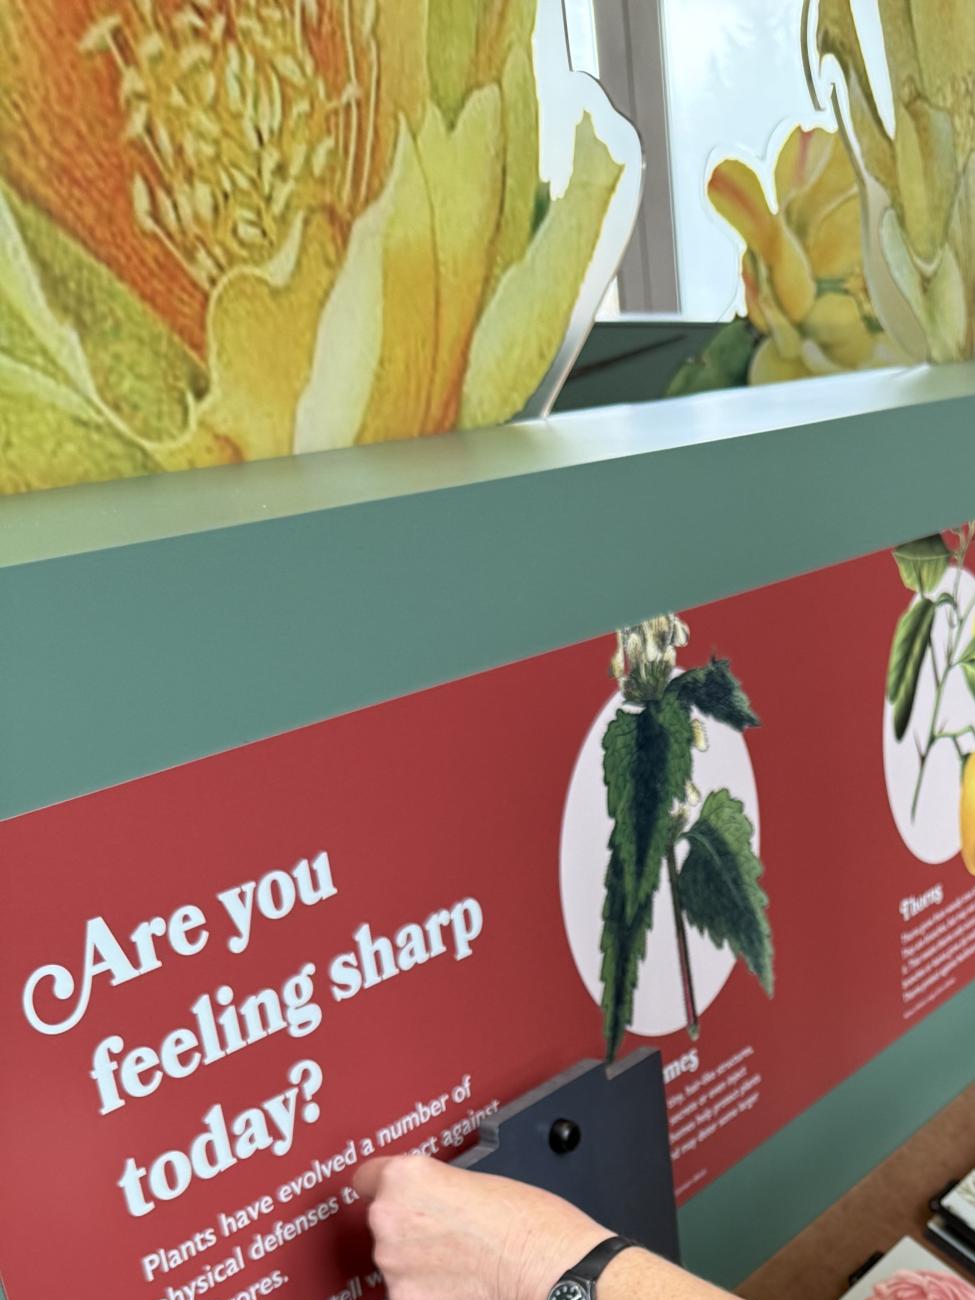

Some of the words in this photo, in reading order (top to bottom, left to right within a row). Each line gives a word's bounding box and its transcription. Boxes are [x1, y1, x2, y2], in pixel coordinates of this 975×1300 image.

[22, 905, 209, 1035] Are
[218, 851, 338, 951] you
[91, 964, 322, 1115] feeling
[329, 897, 484, 1001] sharp
[117, 1059, 323, 1217] today?
[141, 1227, 217, 1282] Plants
[218, 1193, 275, 1237] have
[278, 1140, 357, 1203] evolved
[360, 1137, 376, 1156] a
[376, 1093, 449, 1147] number
[451, 1074, 472, 1103] of
[248, 1197, 339, 1262] defenses
